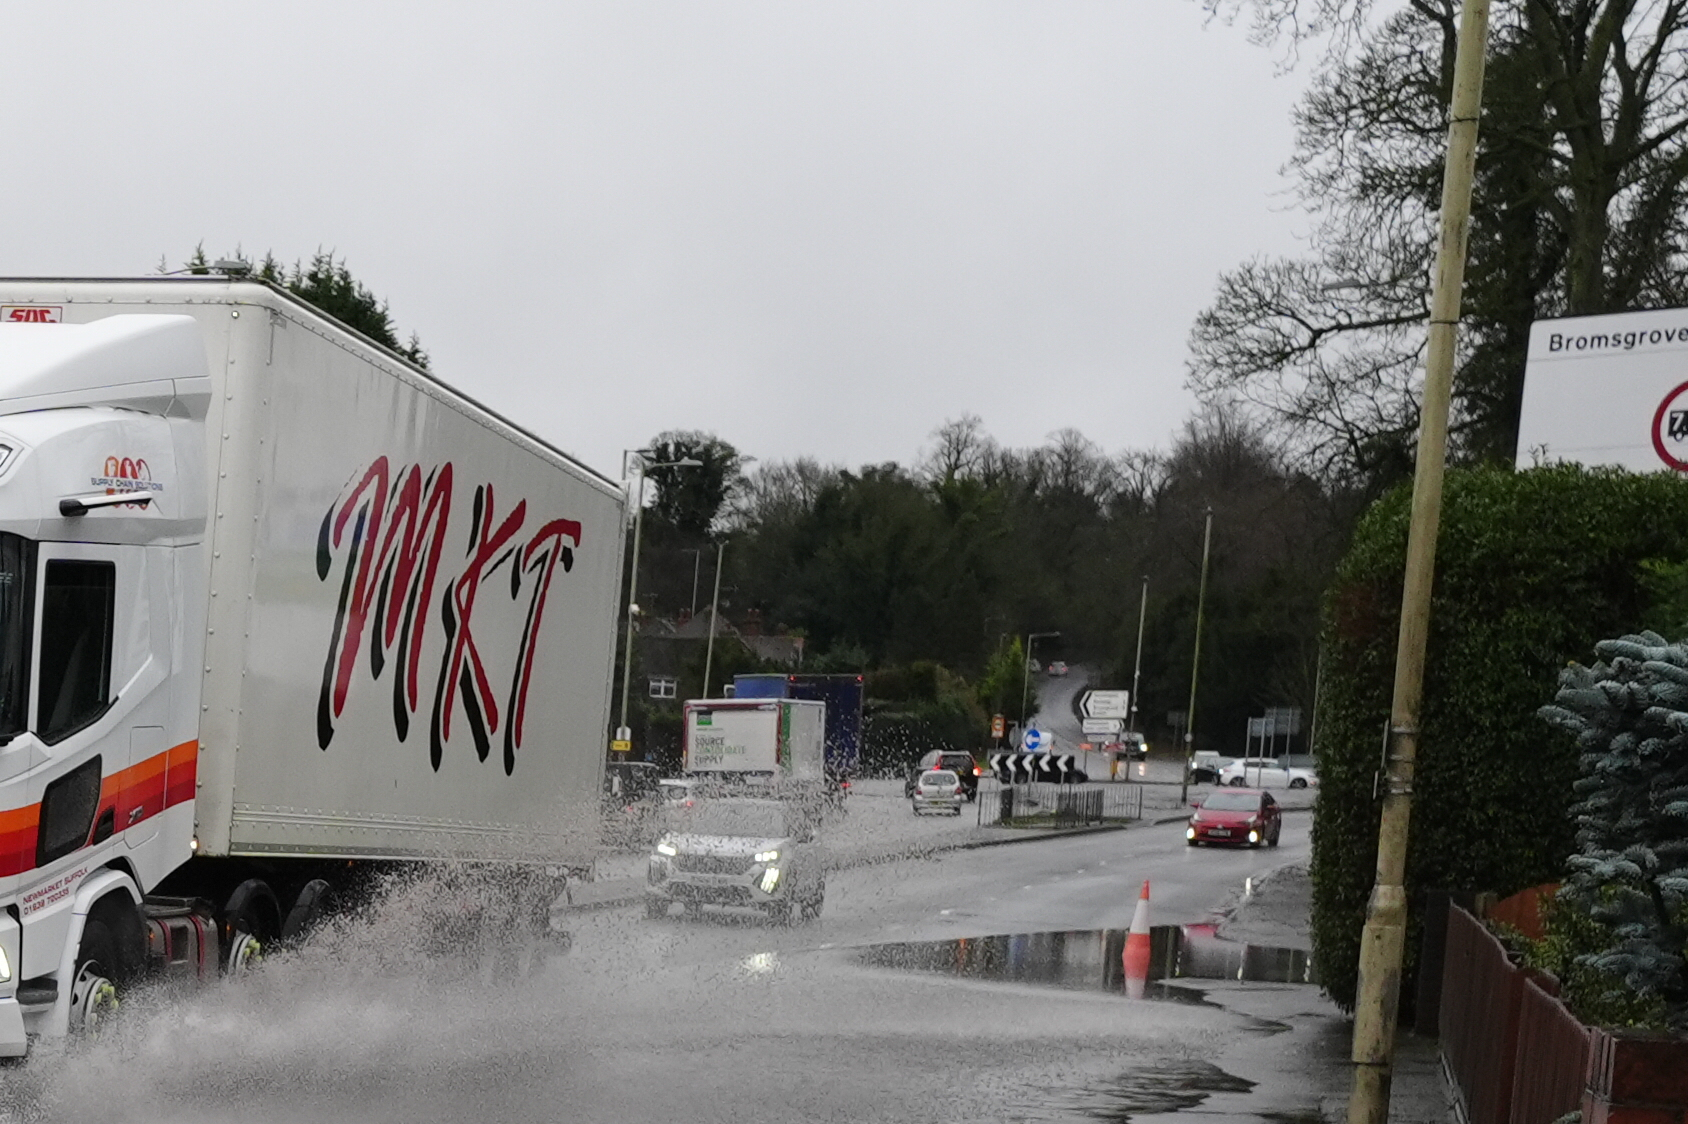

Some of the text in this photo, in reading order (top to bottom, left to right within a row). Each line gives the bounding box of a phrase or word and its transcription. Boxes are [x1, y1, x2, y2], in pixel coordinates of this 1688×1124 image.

[1549, 327, 1688, 352] Bromsgrove
[316, 454, 582, 776] MKT
[23, 866, 89, 904] NEWMARKET SUFFOLK
